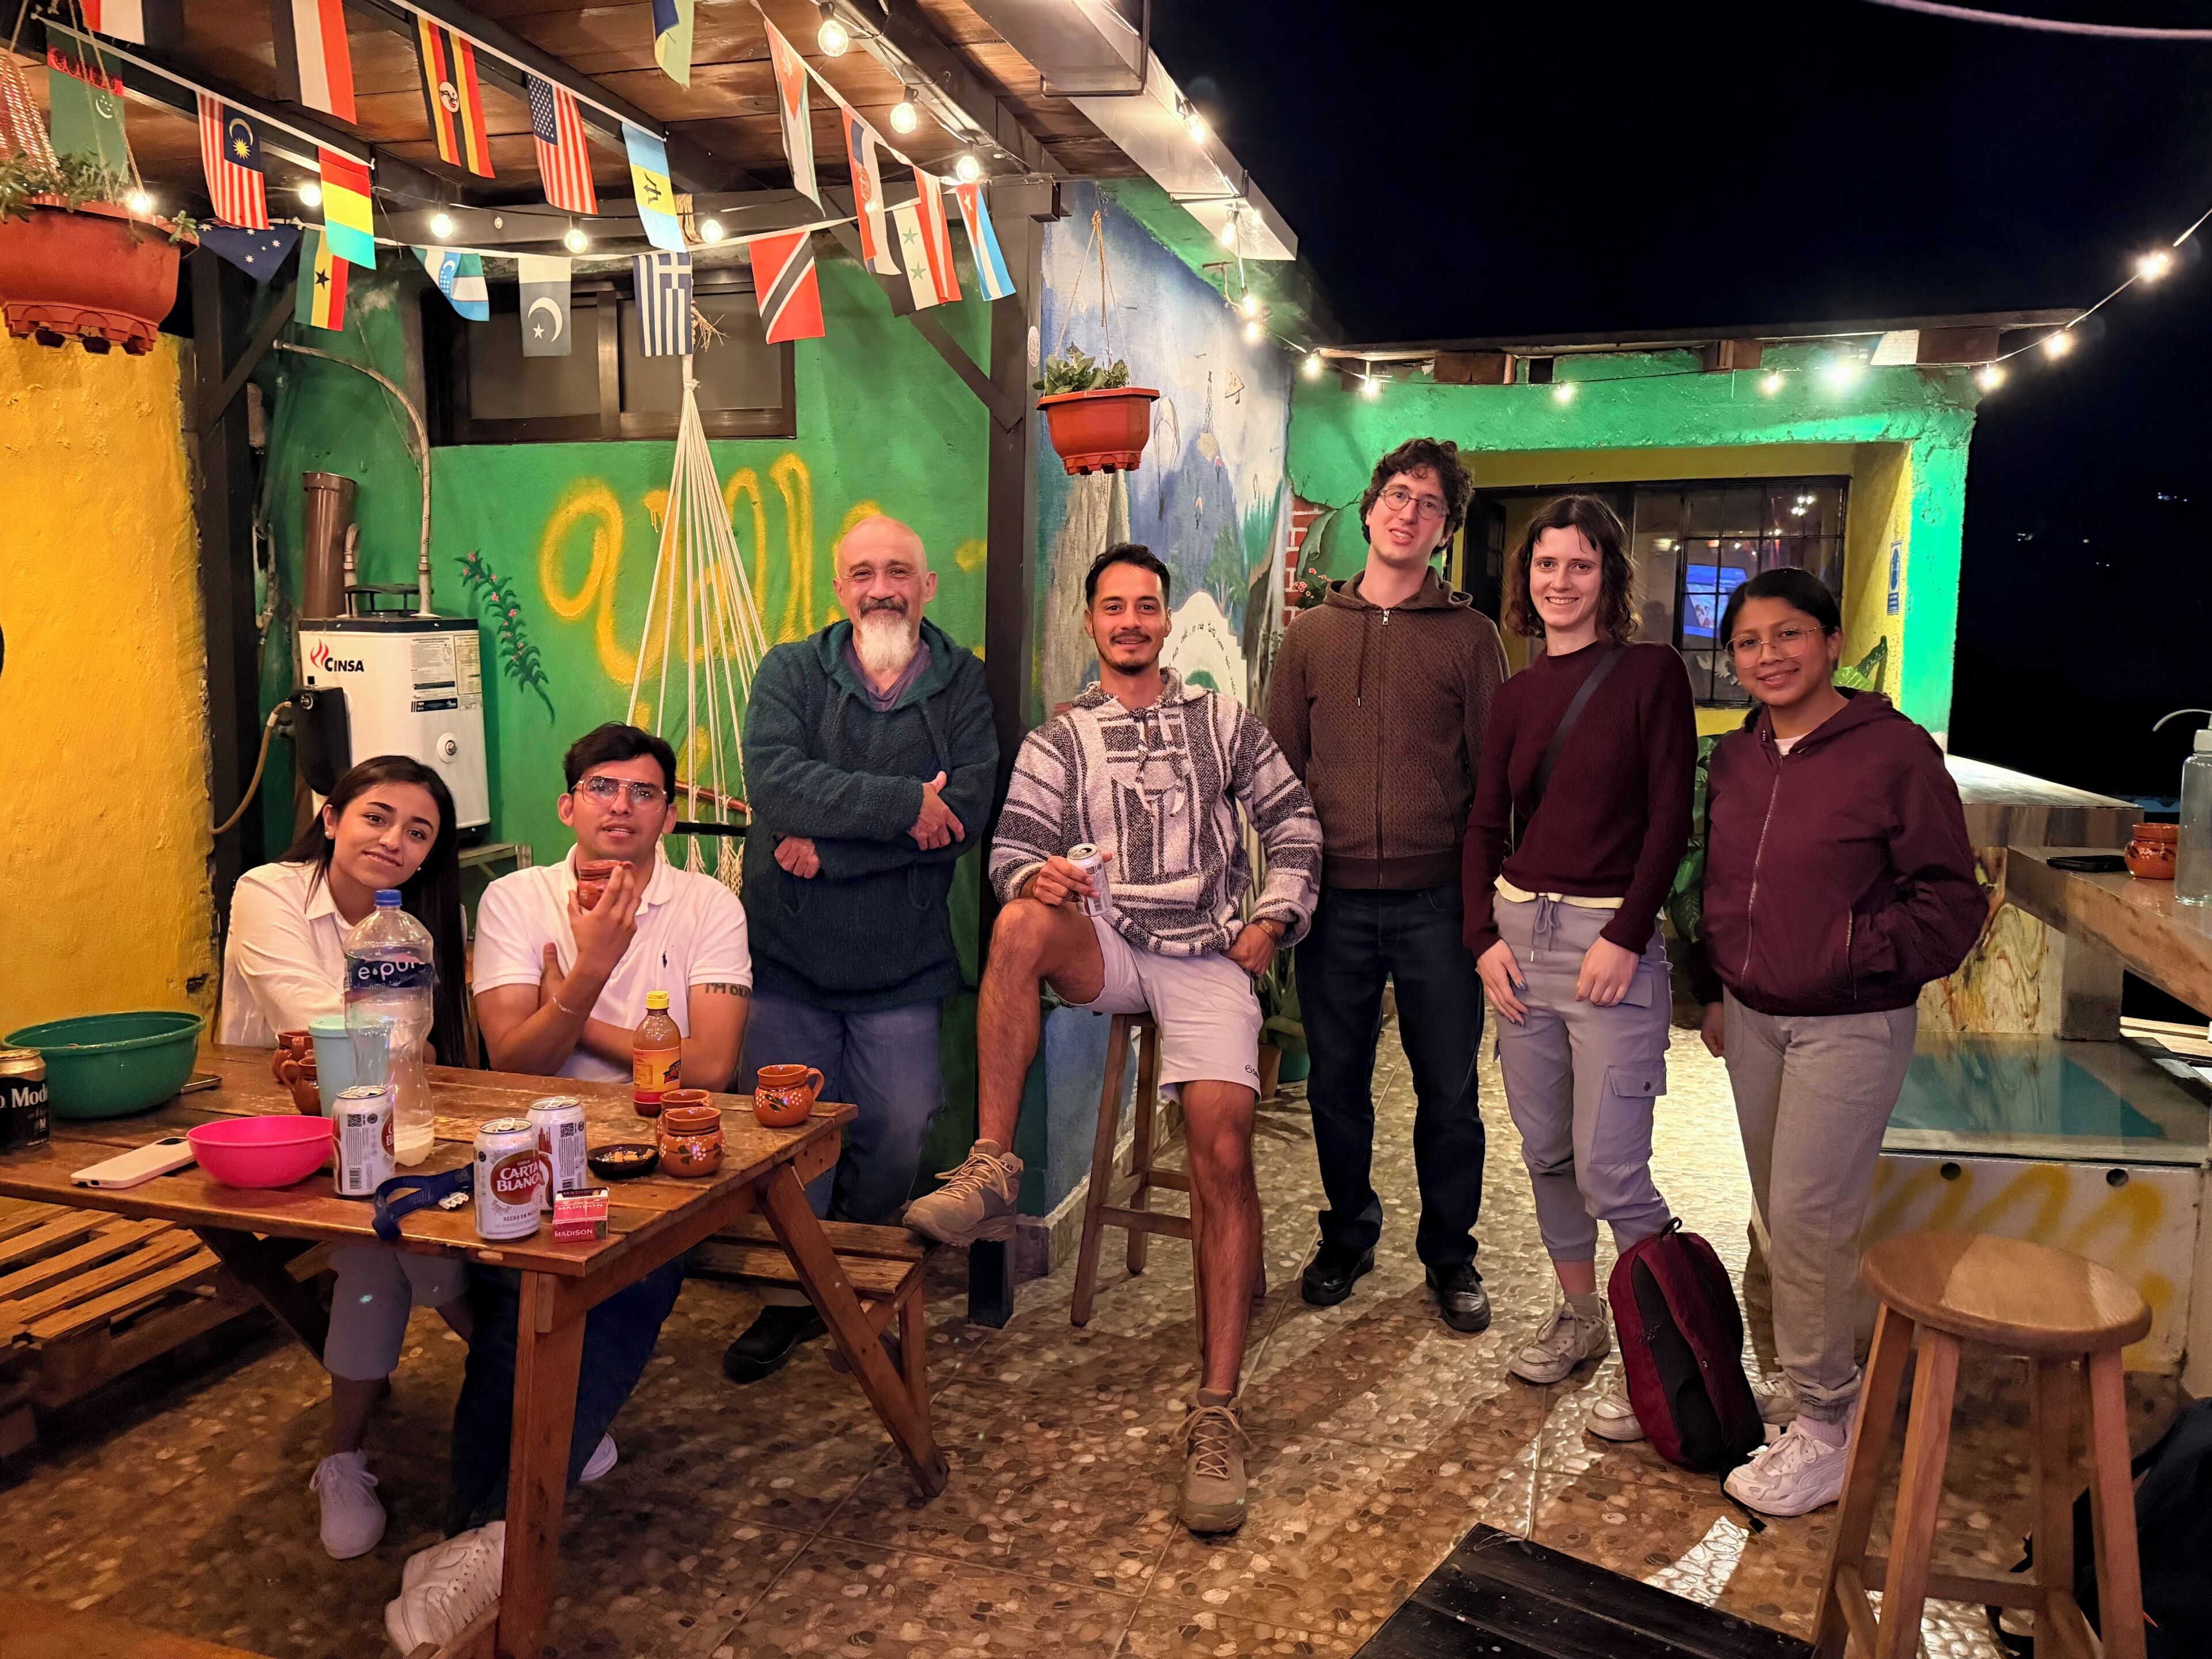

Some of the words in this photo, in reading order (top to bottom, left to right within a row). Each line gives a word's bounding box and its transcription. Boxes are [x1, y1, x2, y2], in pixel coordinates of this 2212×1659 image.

[324, 657, 364, 672] CINSA
[12, 1083, 48, 1108] Mod
[500, 1162, 539, 1180] CARTA
[555, 1229, 593, 1237] MADISON
